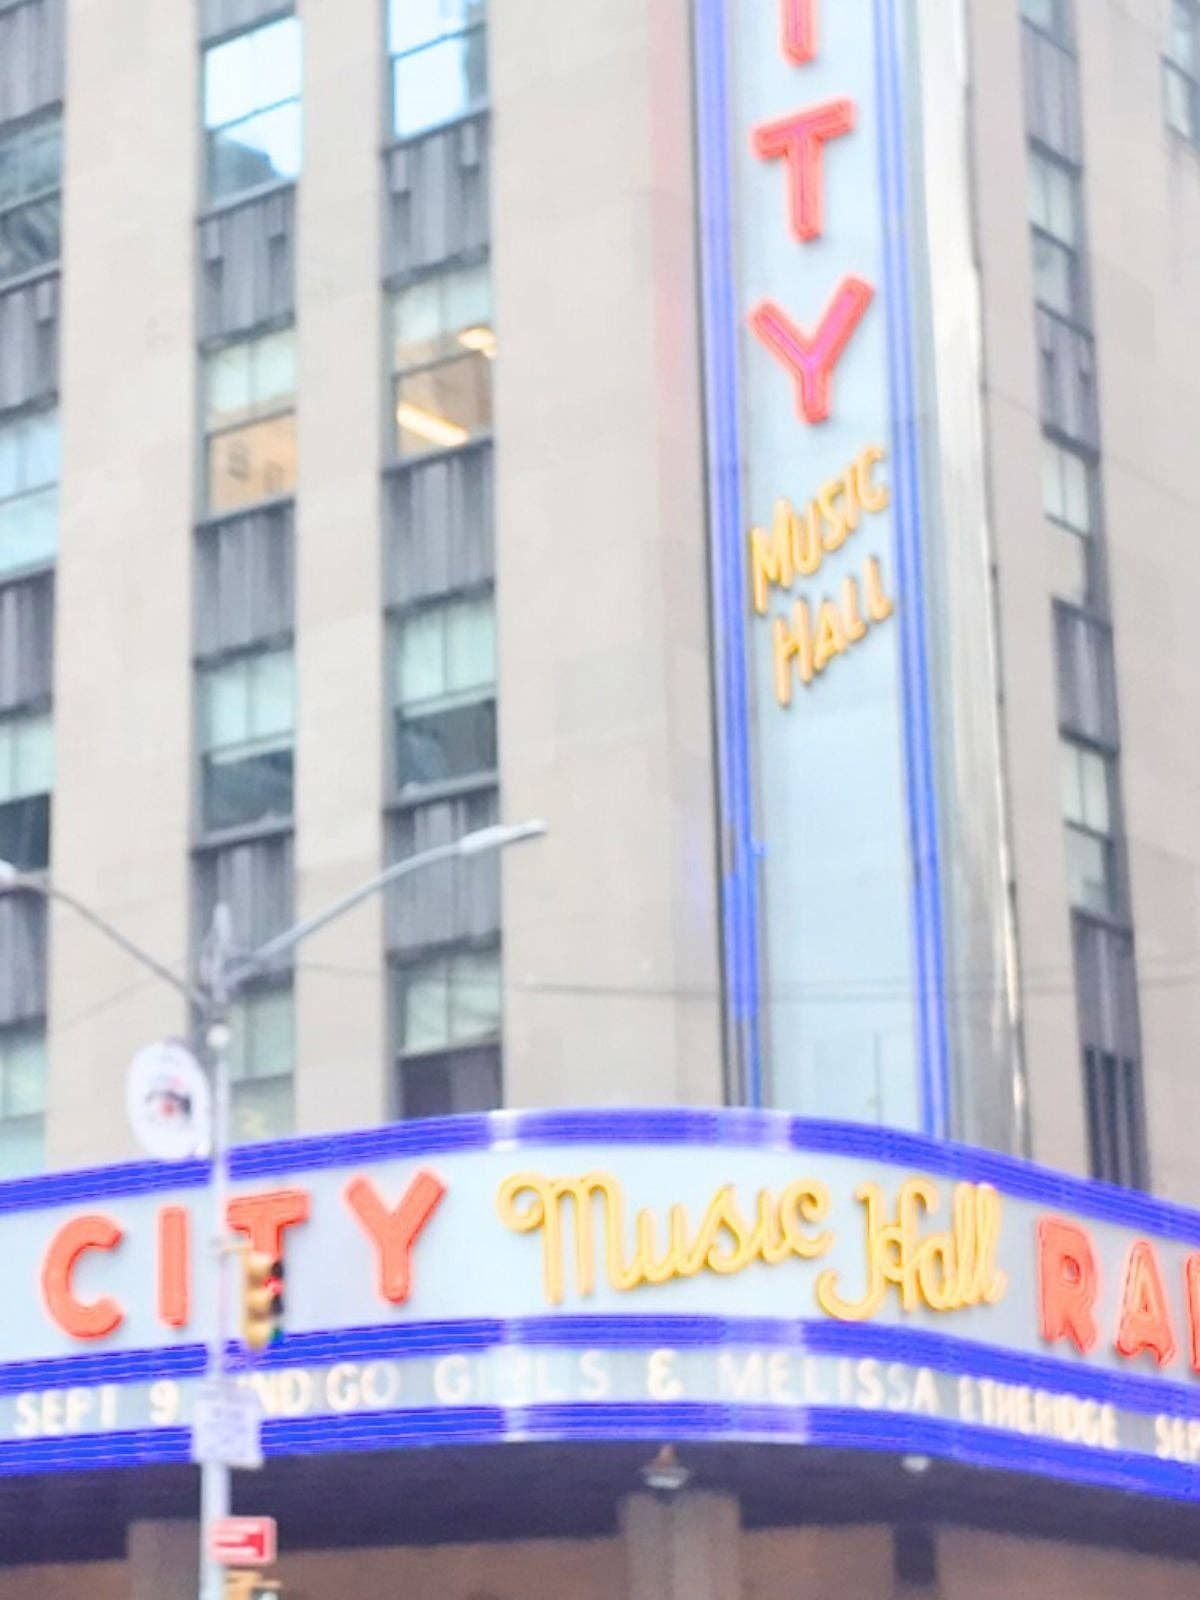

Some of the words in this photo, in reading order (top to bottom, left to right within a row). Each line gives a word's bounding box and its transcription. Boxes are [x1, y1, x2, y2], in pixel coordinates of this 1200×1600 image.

[41, 1170, 447, 1340] CITY
[496, 1171, 834, 1306] Music
[815, 1174, 1008, 1322] Hall
[1037, 1213, 1200, 1376] RA
[14, 1383, 120, 1437] SEPT
[149, 1378, 180, 1426] 9
[648, 1348, 683, 1400] &
[717, 1350, 941, 1416] MELISSA
